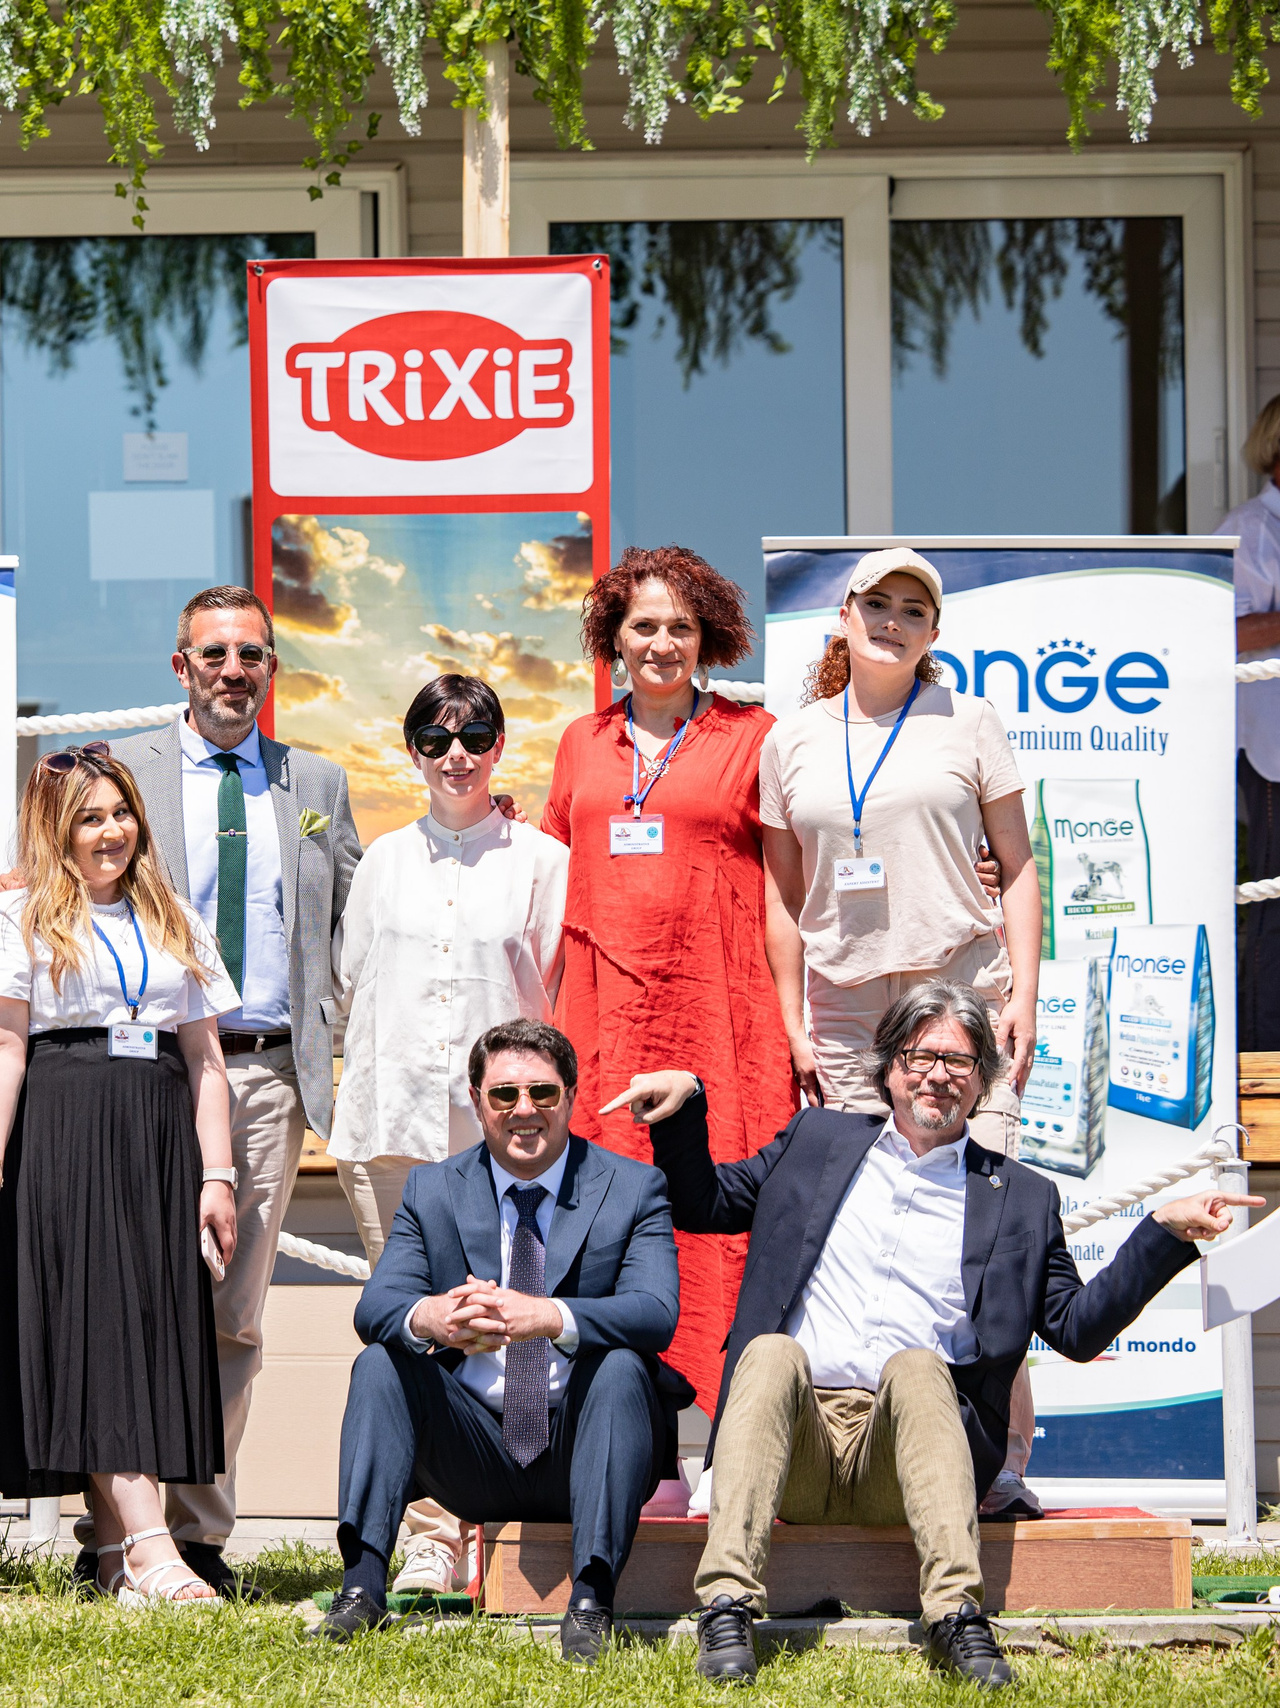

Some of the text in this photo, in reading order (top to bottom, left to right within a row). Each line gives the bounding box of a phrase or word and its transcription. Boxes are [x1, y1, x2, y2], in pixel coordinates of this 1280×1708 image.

[1007, 725, 1169, 756] emium Quality
[1107, 903, 1133, 911] POLLO
[1127, 1337, 1196, 1353] mondo
